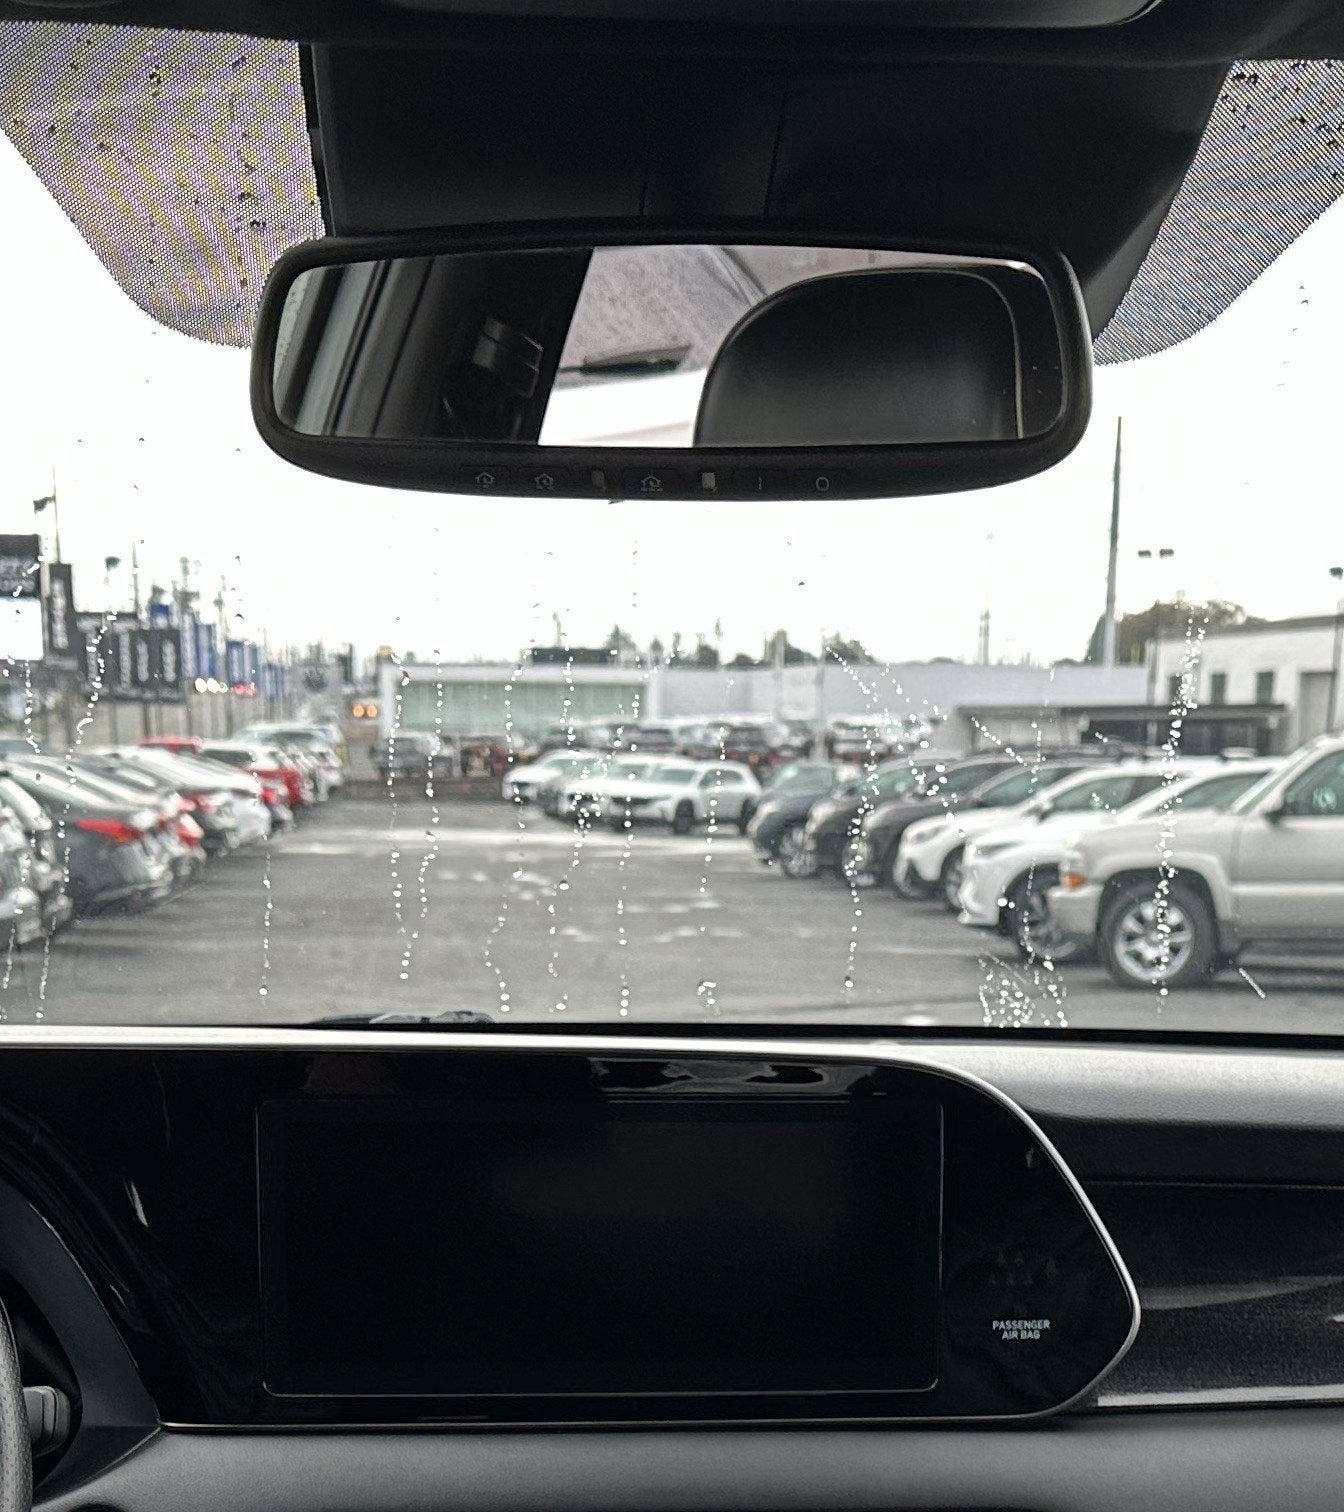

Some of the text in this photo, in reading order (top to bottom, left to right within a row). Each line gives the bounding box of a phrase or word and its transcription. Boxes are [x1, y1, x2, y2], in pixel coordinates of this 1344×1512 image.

[992, 1319, 1051, 1331] PASSENGER
[1001, 1330, 1041, 1340] AIR BAG
